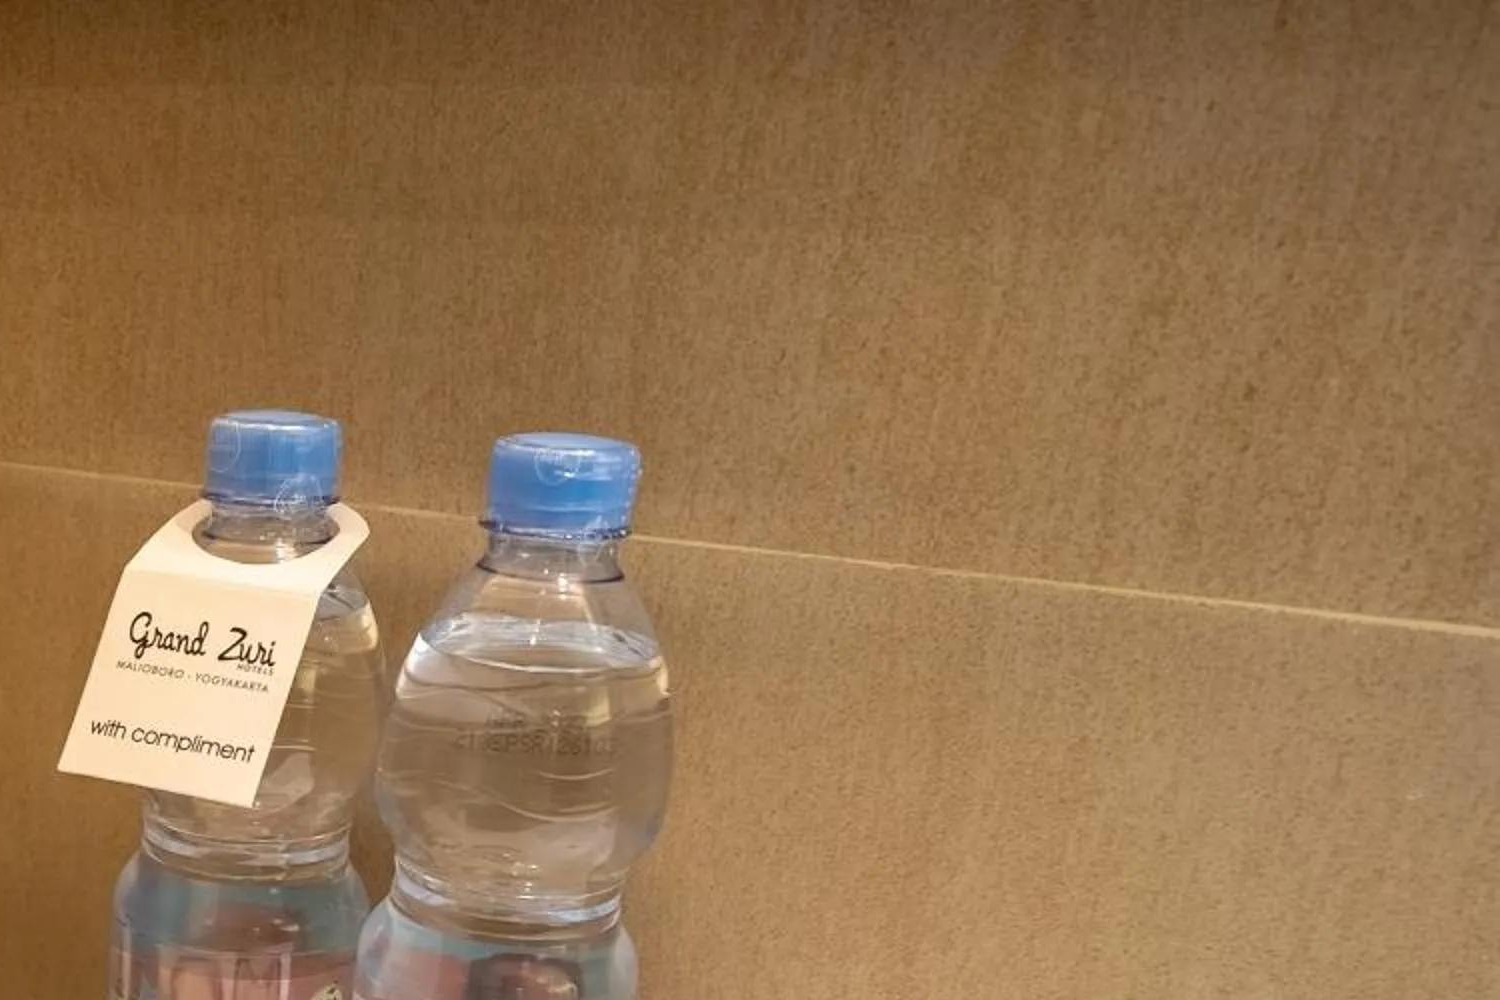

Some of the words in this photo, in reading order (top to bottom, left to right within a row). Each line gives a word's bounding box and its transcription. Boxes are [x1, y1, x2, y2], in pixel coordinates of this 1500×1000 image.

[129, 611, 209, 659] Grand
[217, 626, 277, 667] Zuri
[116, 660, 185, 680] MALIOBORO
[195, 672, 269, 692] YOGYAKARTA
[236, 663, 275, 676] HOTELS
[90, 719, 127, 740] with
[131, 727, 256, 764] compliment
